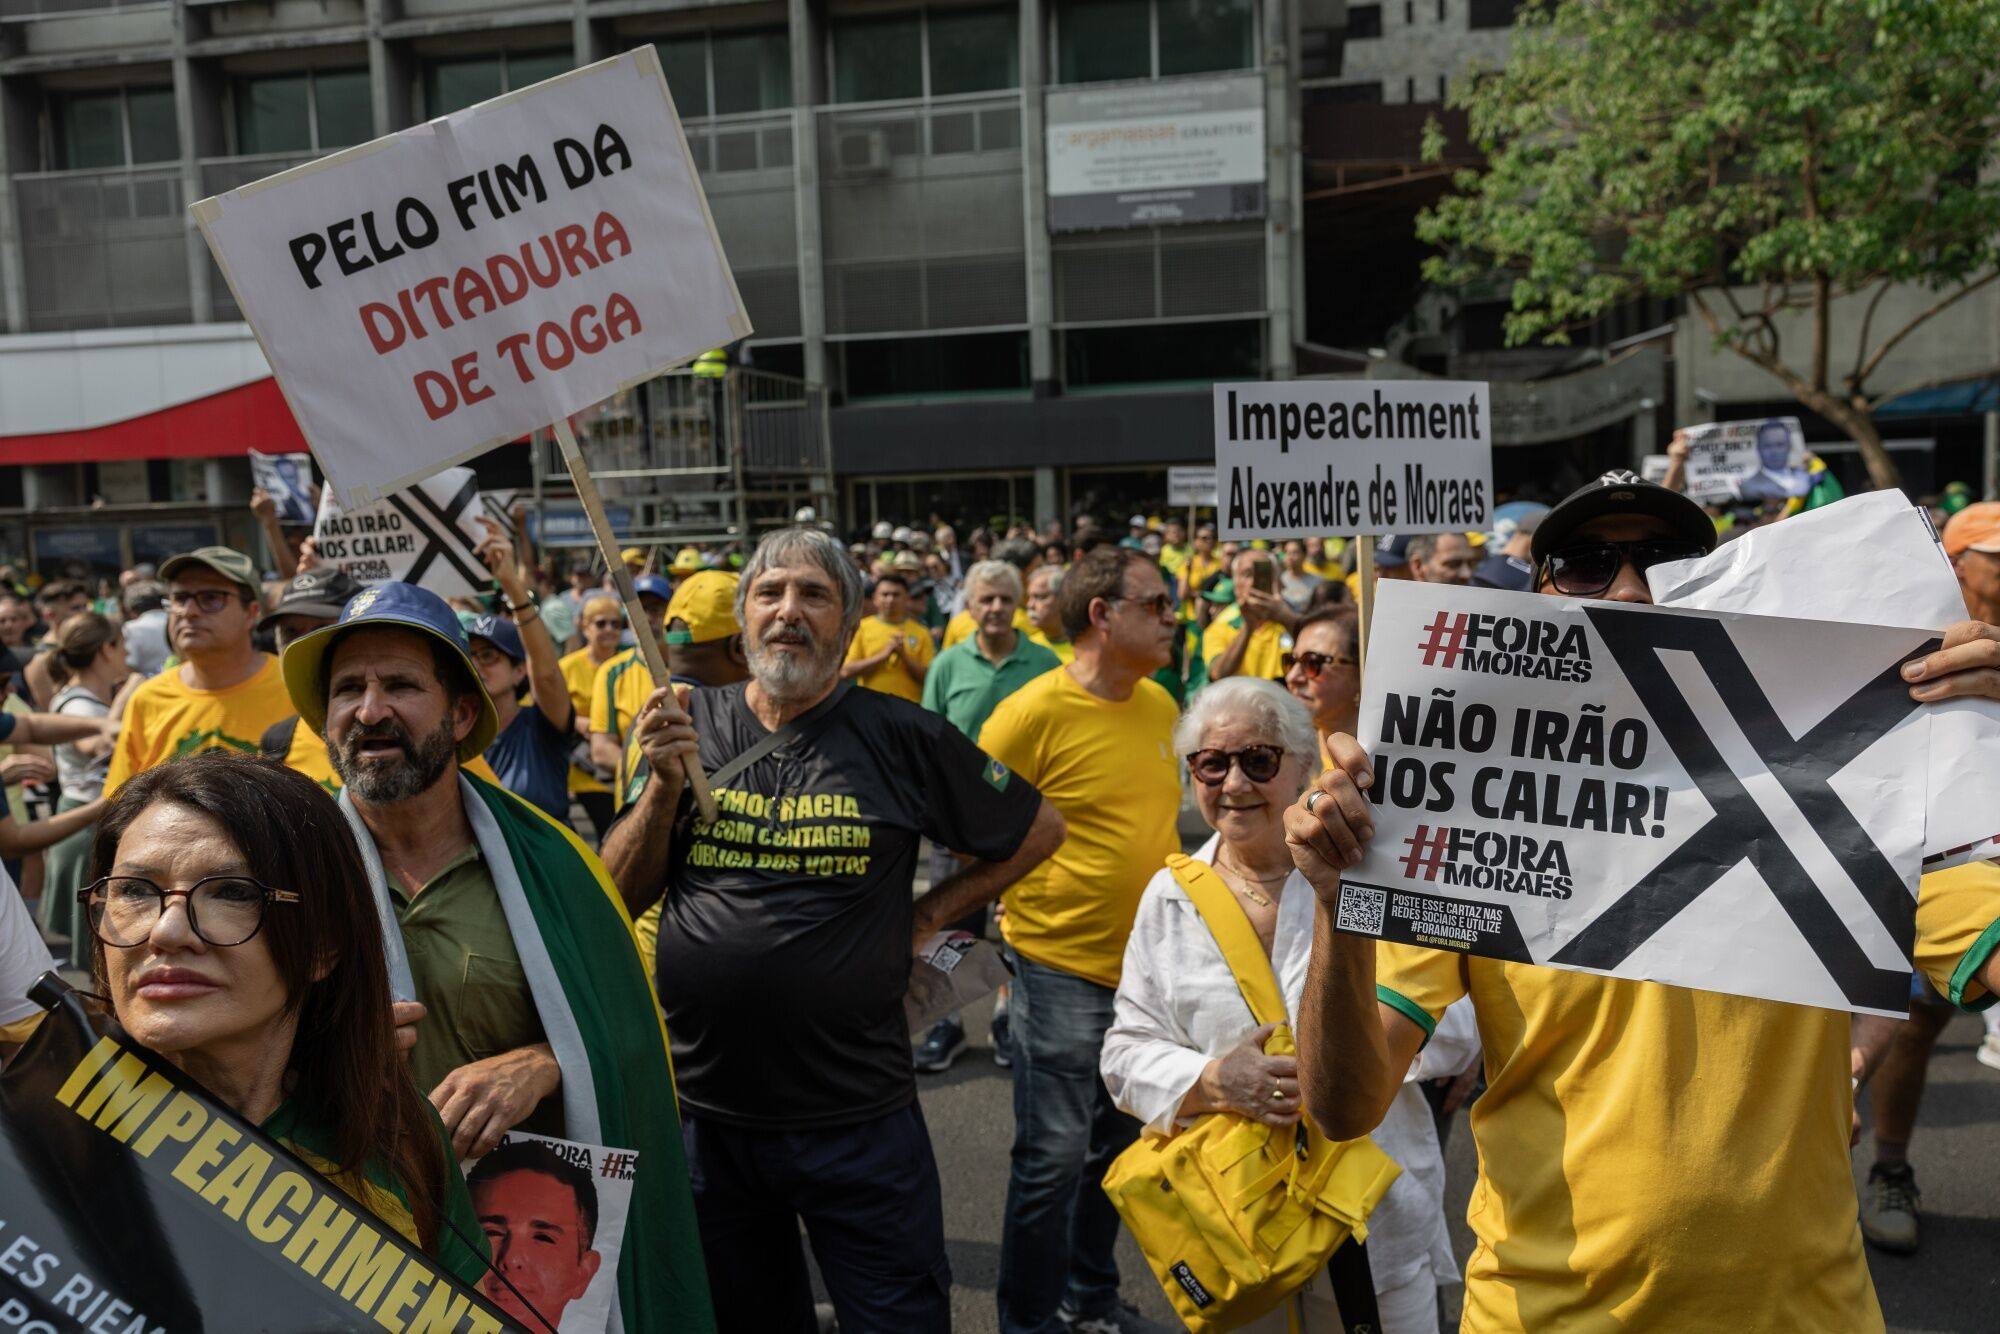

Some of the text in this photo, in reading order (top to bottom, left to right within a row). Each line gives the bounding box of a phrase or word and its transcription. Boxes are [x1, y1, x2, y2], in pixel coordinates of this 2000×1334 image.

[289, 123, 632, 289] PELO FIM DA
[359, 211, 632, 355] DITADURA
[413, 293, 643, 420] DE TOGA
[1228, 389, 1481, 453] Impeachment
[1228, 463, 1485, 529] Alexandre de Moraes
[357, 508, 402, 532] IRÃO
[353, 534, 415, 556] CALAR!
[1418, 611, 1591, 668] #FORA
[1461, 648, 1592, 683] MORAES
[1380, 687, 1648, 769] NÃO IRÃO
[1471, 767, 1669, 839] CALAR!
[712, 819, 755, 844] COM
[755, 853, 800, 873] DOS
[1399, 824, 1571, 882] #FORA
[1443, 862, 1573, 900] MORAES
[1392, 905, 1502, 934] REDES SOCIAIS E UTILIZE
[1393, 893, 1503, 921] POSTE ESSE CARTAZ NAS
[1411, 920, 1478, 942] #FORAMORAES
[1416, 934, 1428, 942] SIGA
